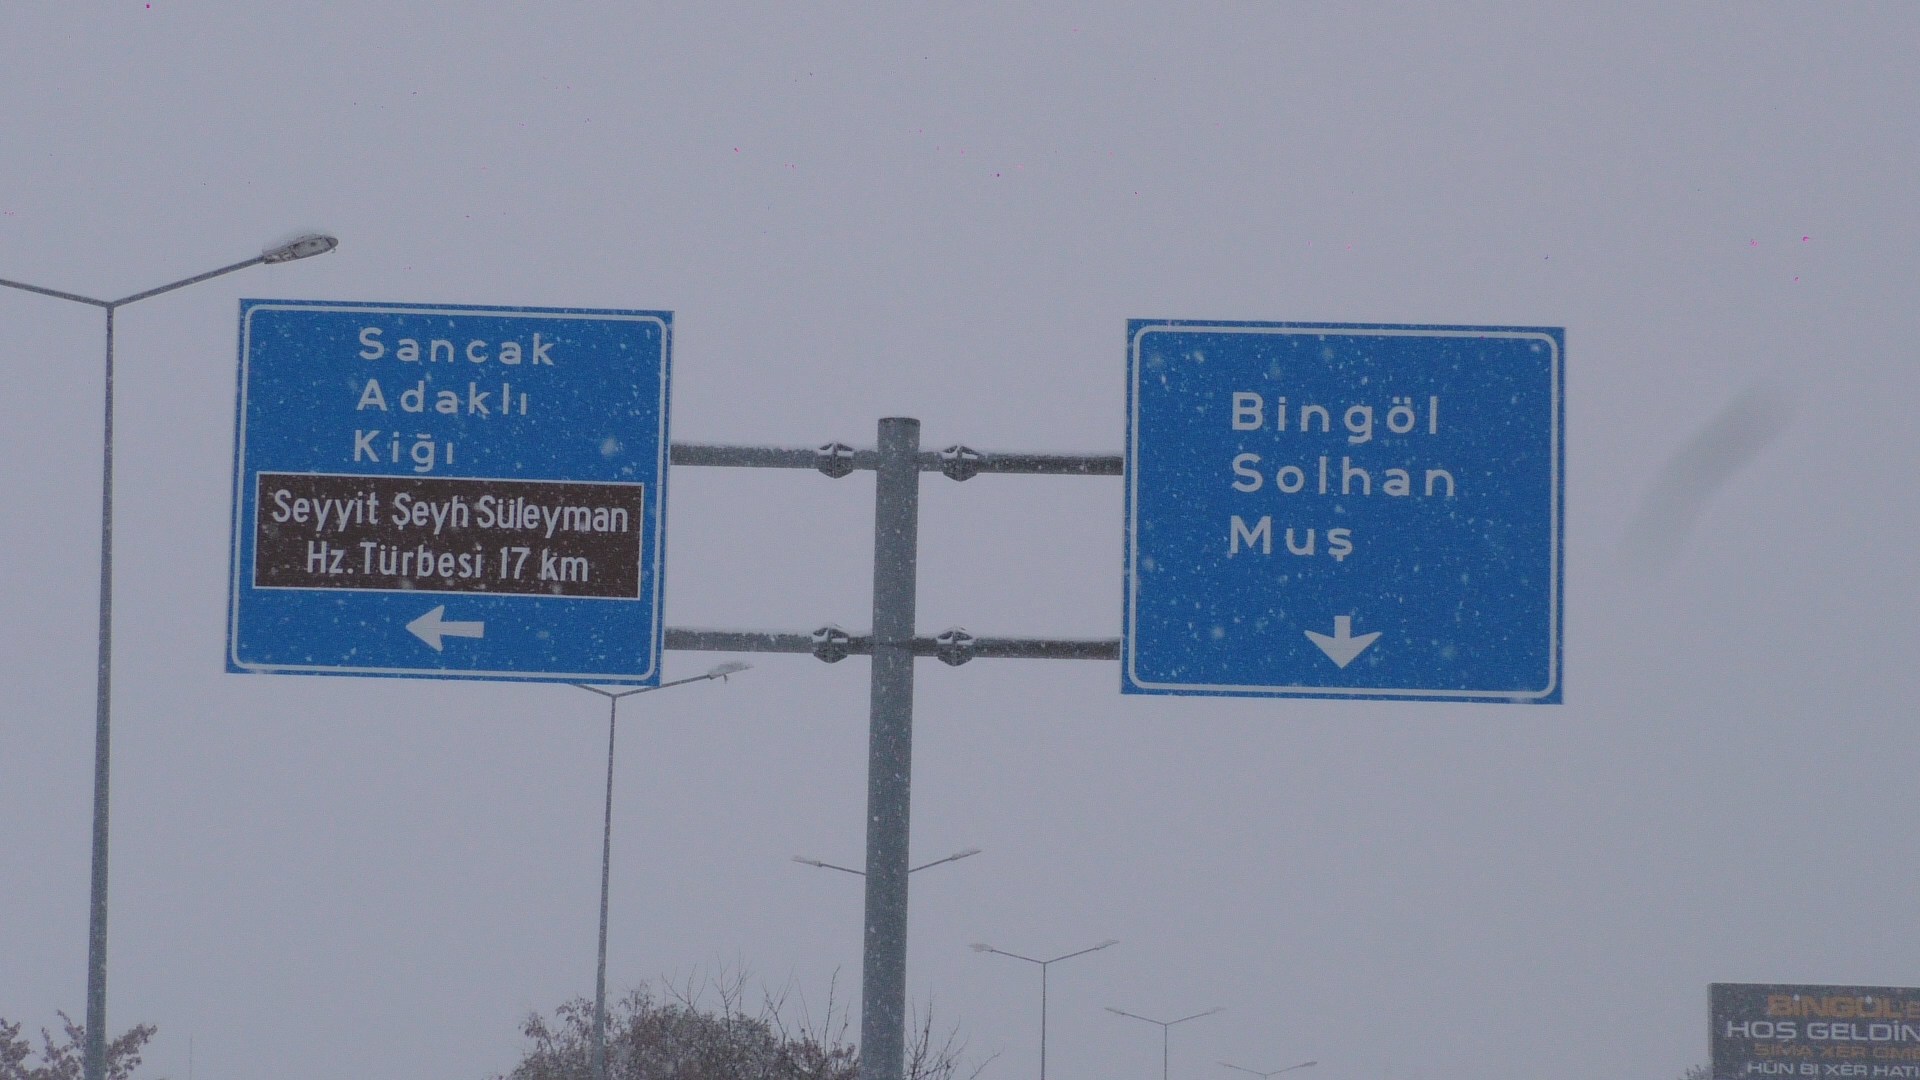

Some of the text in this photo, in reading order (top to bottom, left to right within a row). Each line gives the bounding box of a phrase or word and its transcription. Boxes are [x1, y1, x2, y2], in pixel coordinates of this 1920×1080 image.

[358, 326, 555, 367] Sancak
[356, 378, 528, 416] Adaklı
[1231, 391, 1438, 443] Bingöl
[353, 429, 454, 473] Kiğı
[1231, 452, 1455, 497] Solhan
[272, 489, 628, 539] Seyyit Şeyh Süleyman
[1229, 515, 1354, 562] Muş
[499, 546, 531, 580] 17
[540, 547, 589, 582] km
[1726, 1020, 1797, 1042] HOŞ
